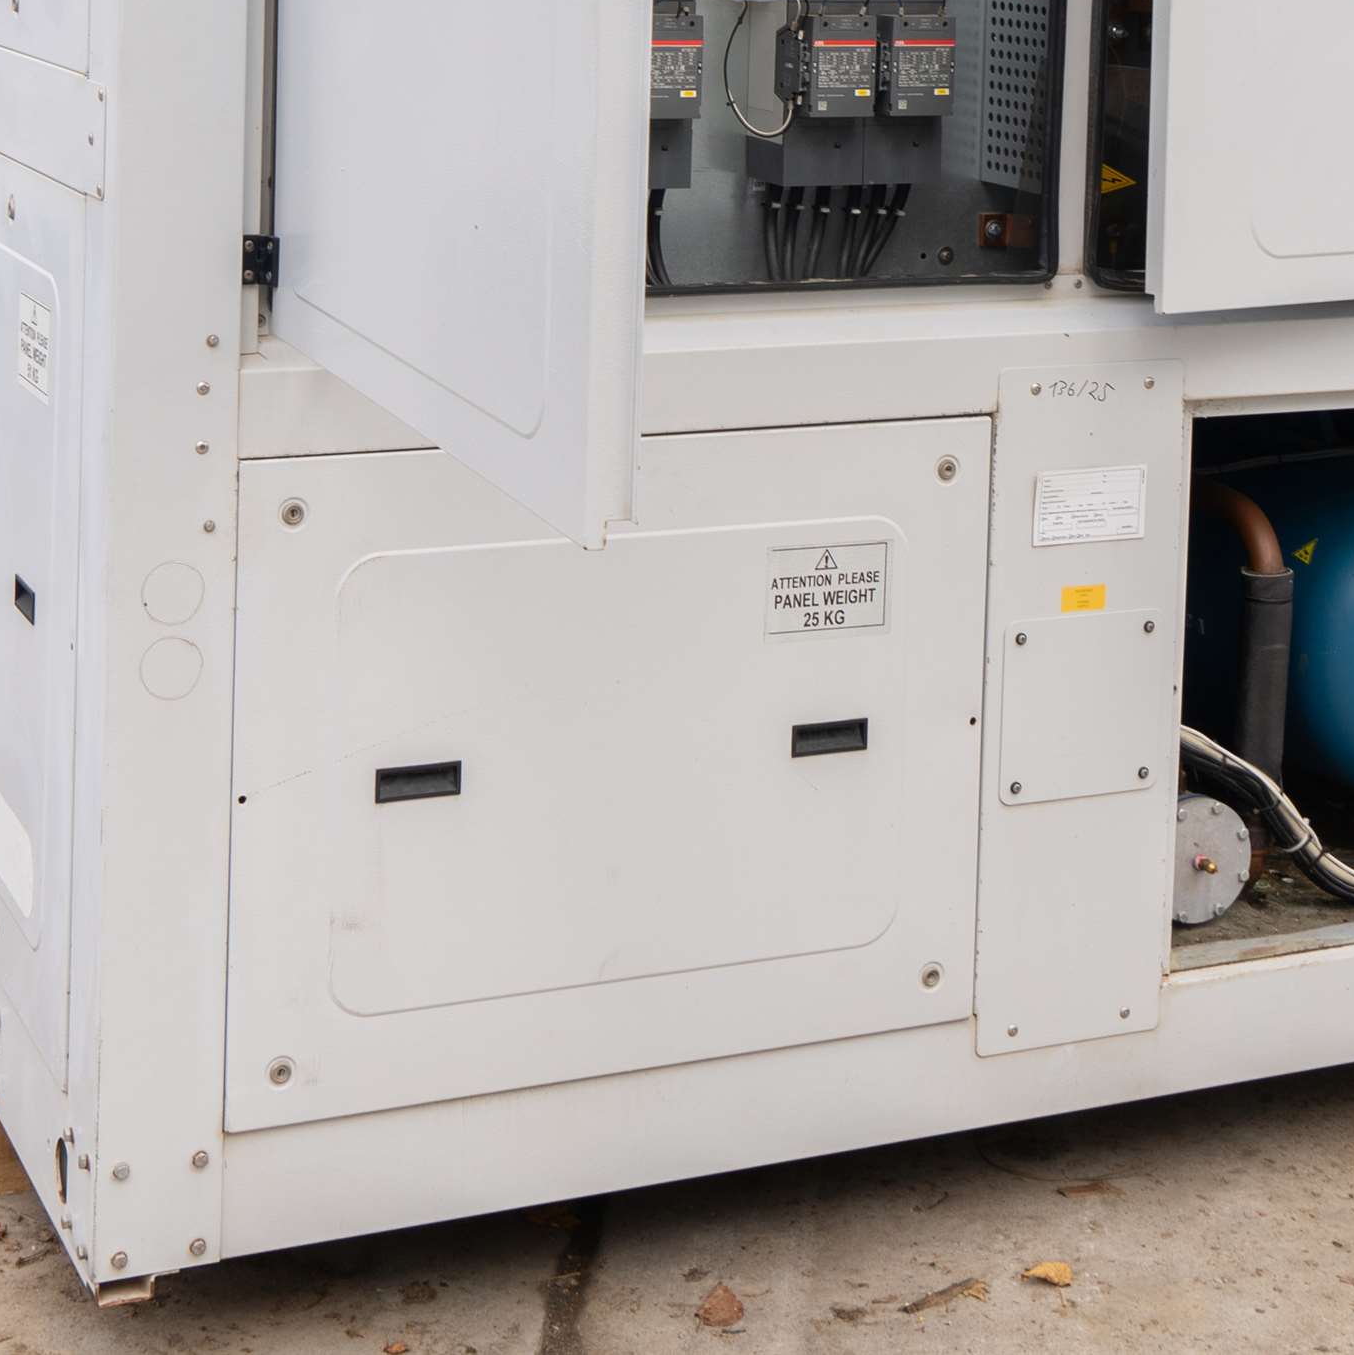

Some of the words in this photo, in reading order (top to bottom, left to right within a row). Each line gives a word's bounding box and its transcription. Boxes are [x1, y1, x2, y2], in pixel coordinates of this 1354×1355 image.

[771, 574, 832, 590] ATTENTION
[838, 570, 880, 585] PLEASE
[774, 592, 819, 609] PANEL
[823, 588, 876, 606] WEIGHT
[803, 612, 819, 627] 25
[824, 609, 845, 626] KG
